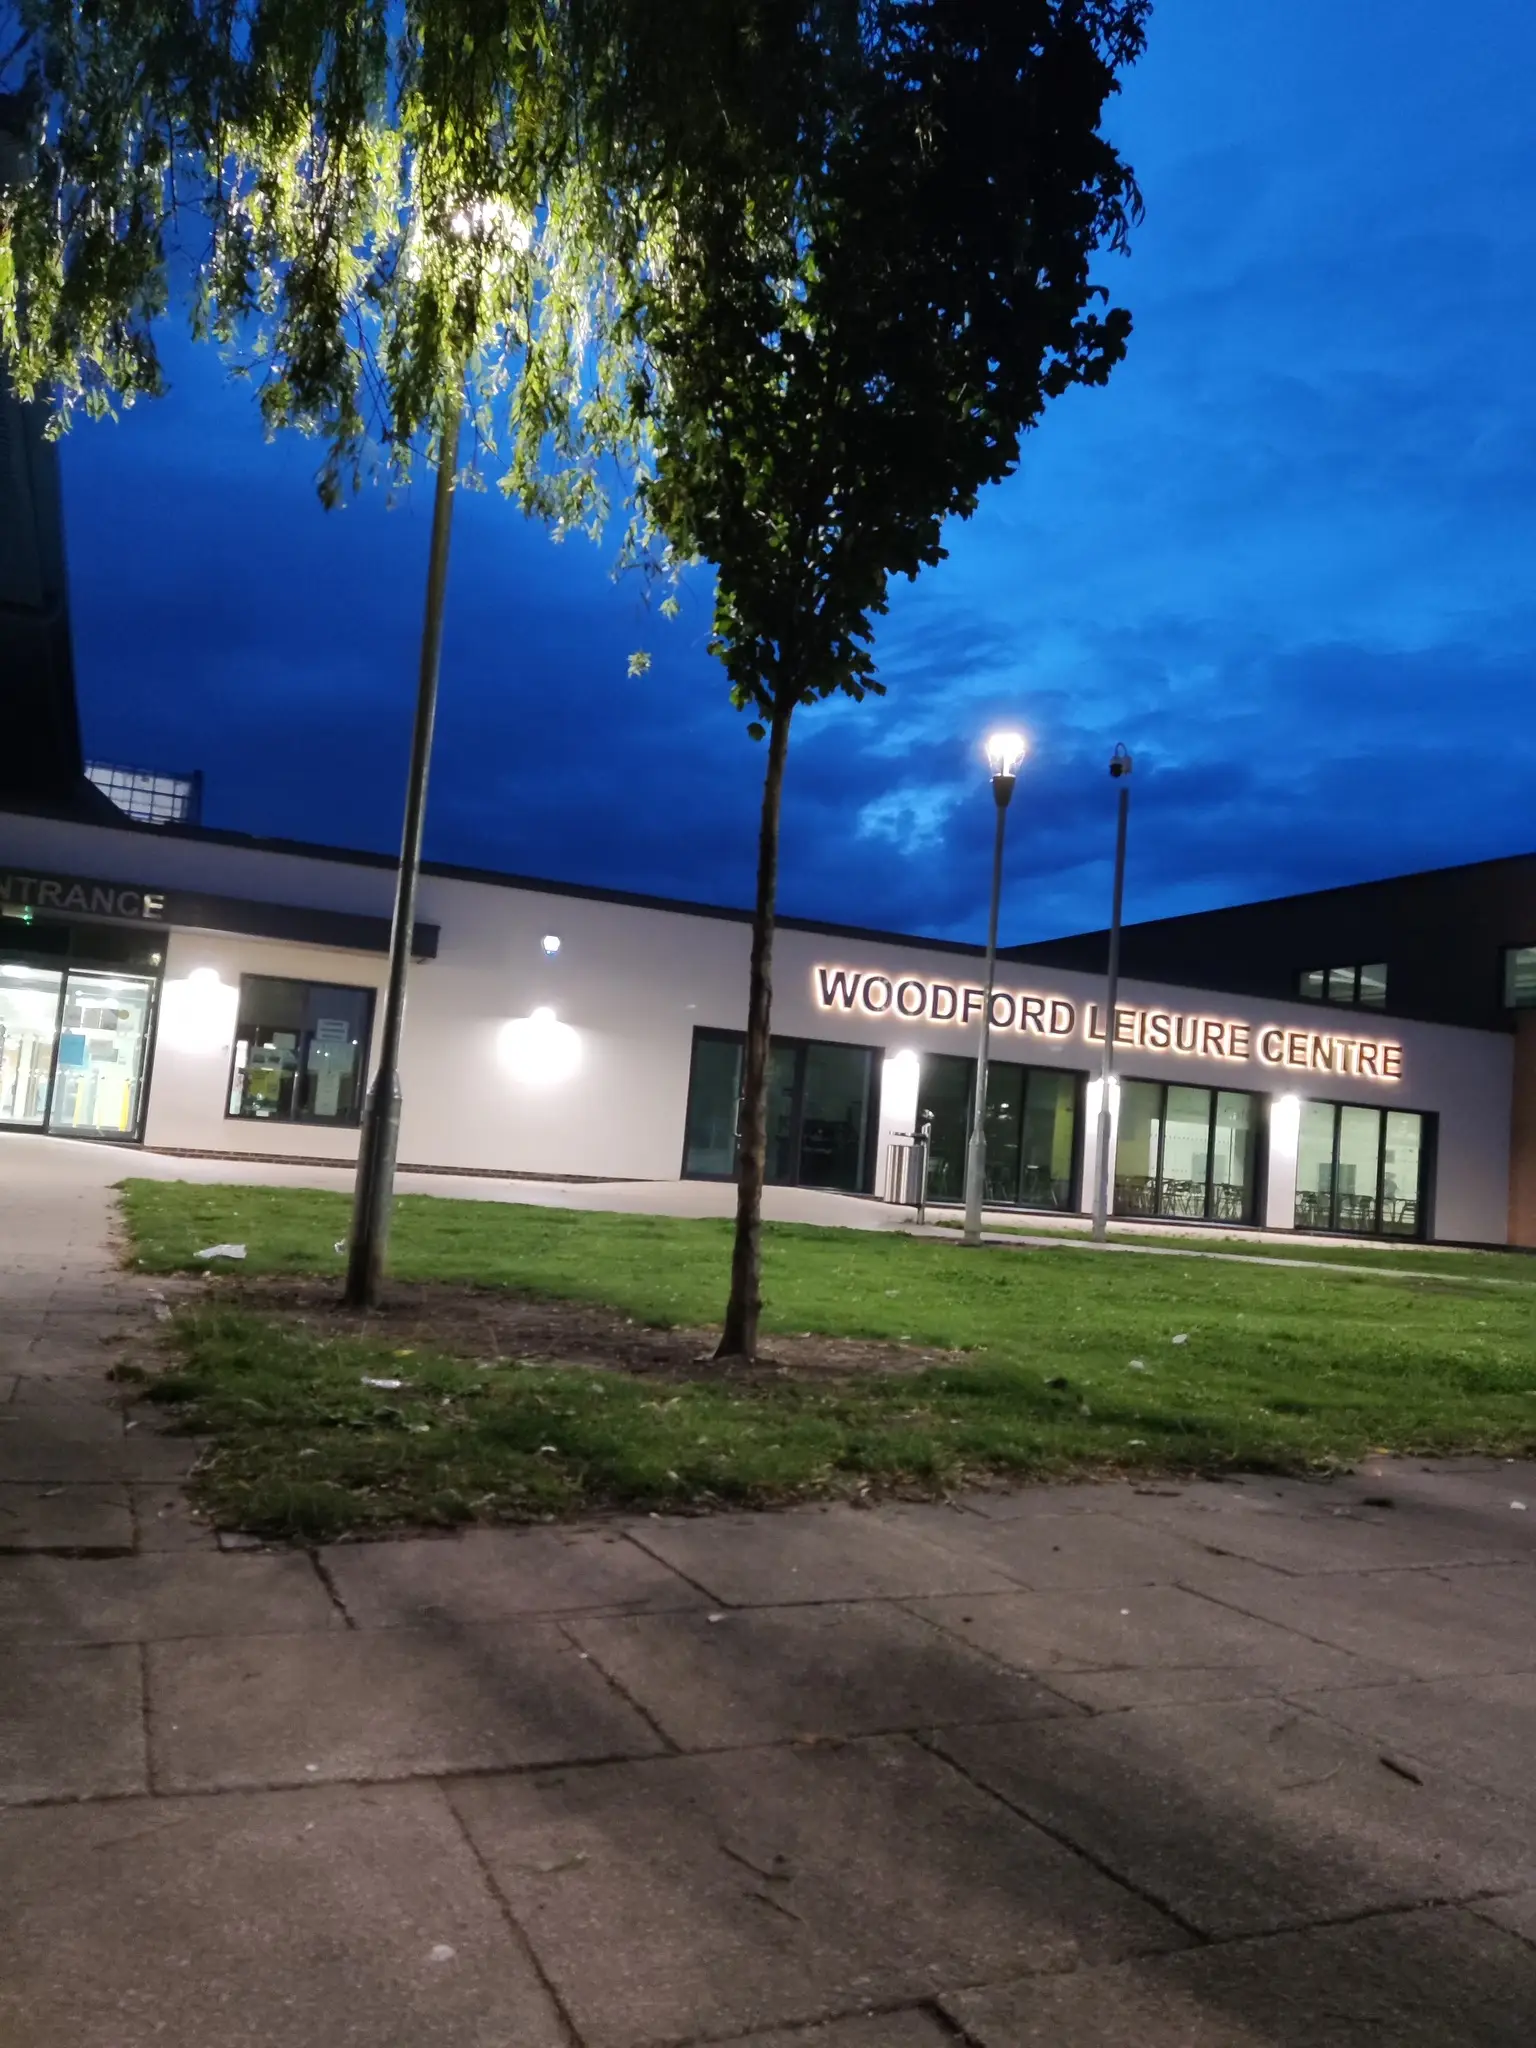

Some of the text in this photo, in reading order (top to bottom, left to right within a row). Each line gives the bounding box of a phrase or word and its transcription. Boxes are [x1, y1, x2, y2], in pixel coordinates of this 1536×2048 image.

[818, 968, 1403, 1079] WOODFORD LEISURE CENTRE
